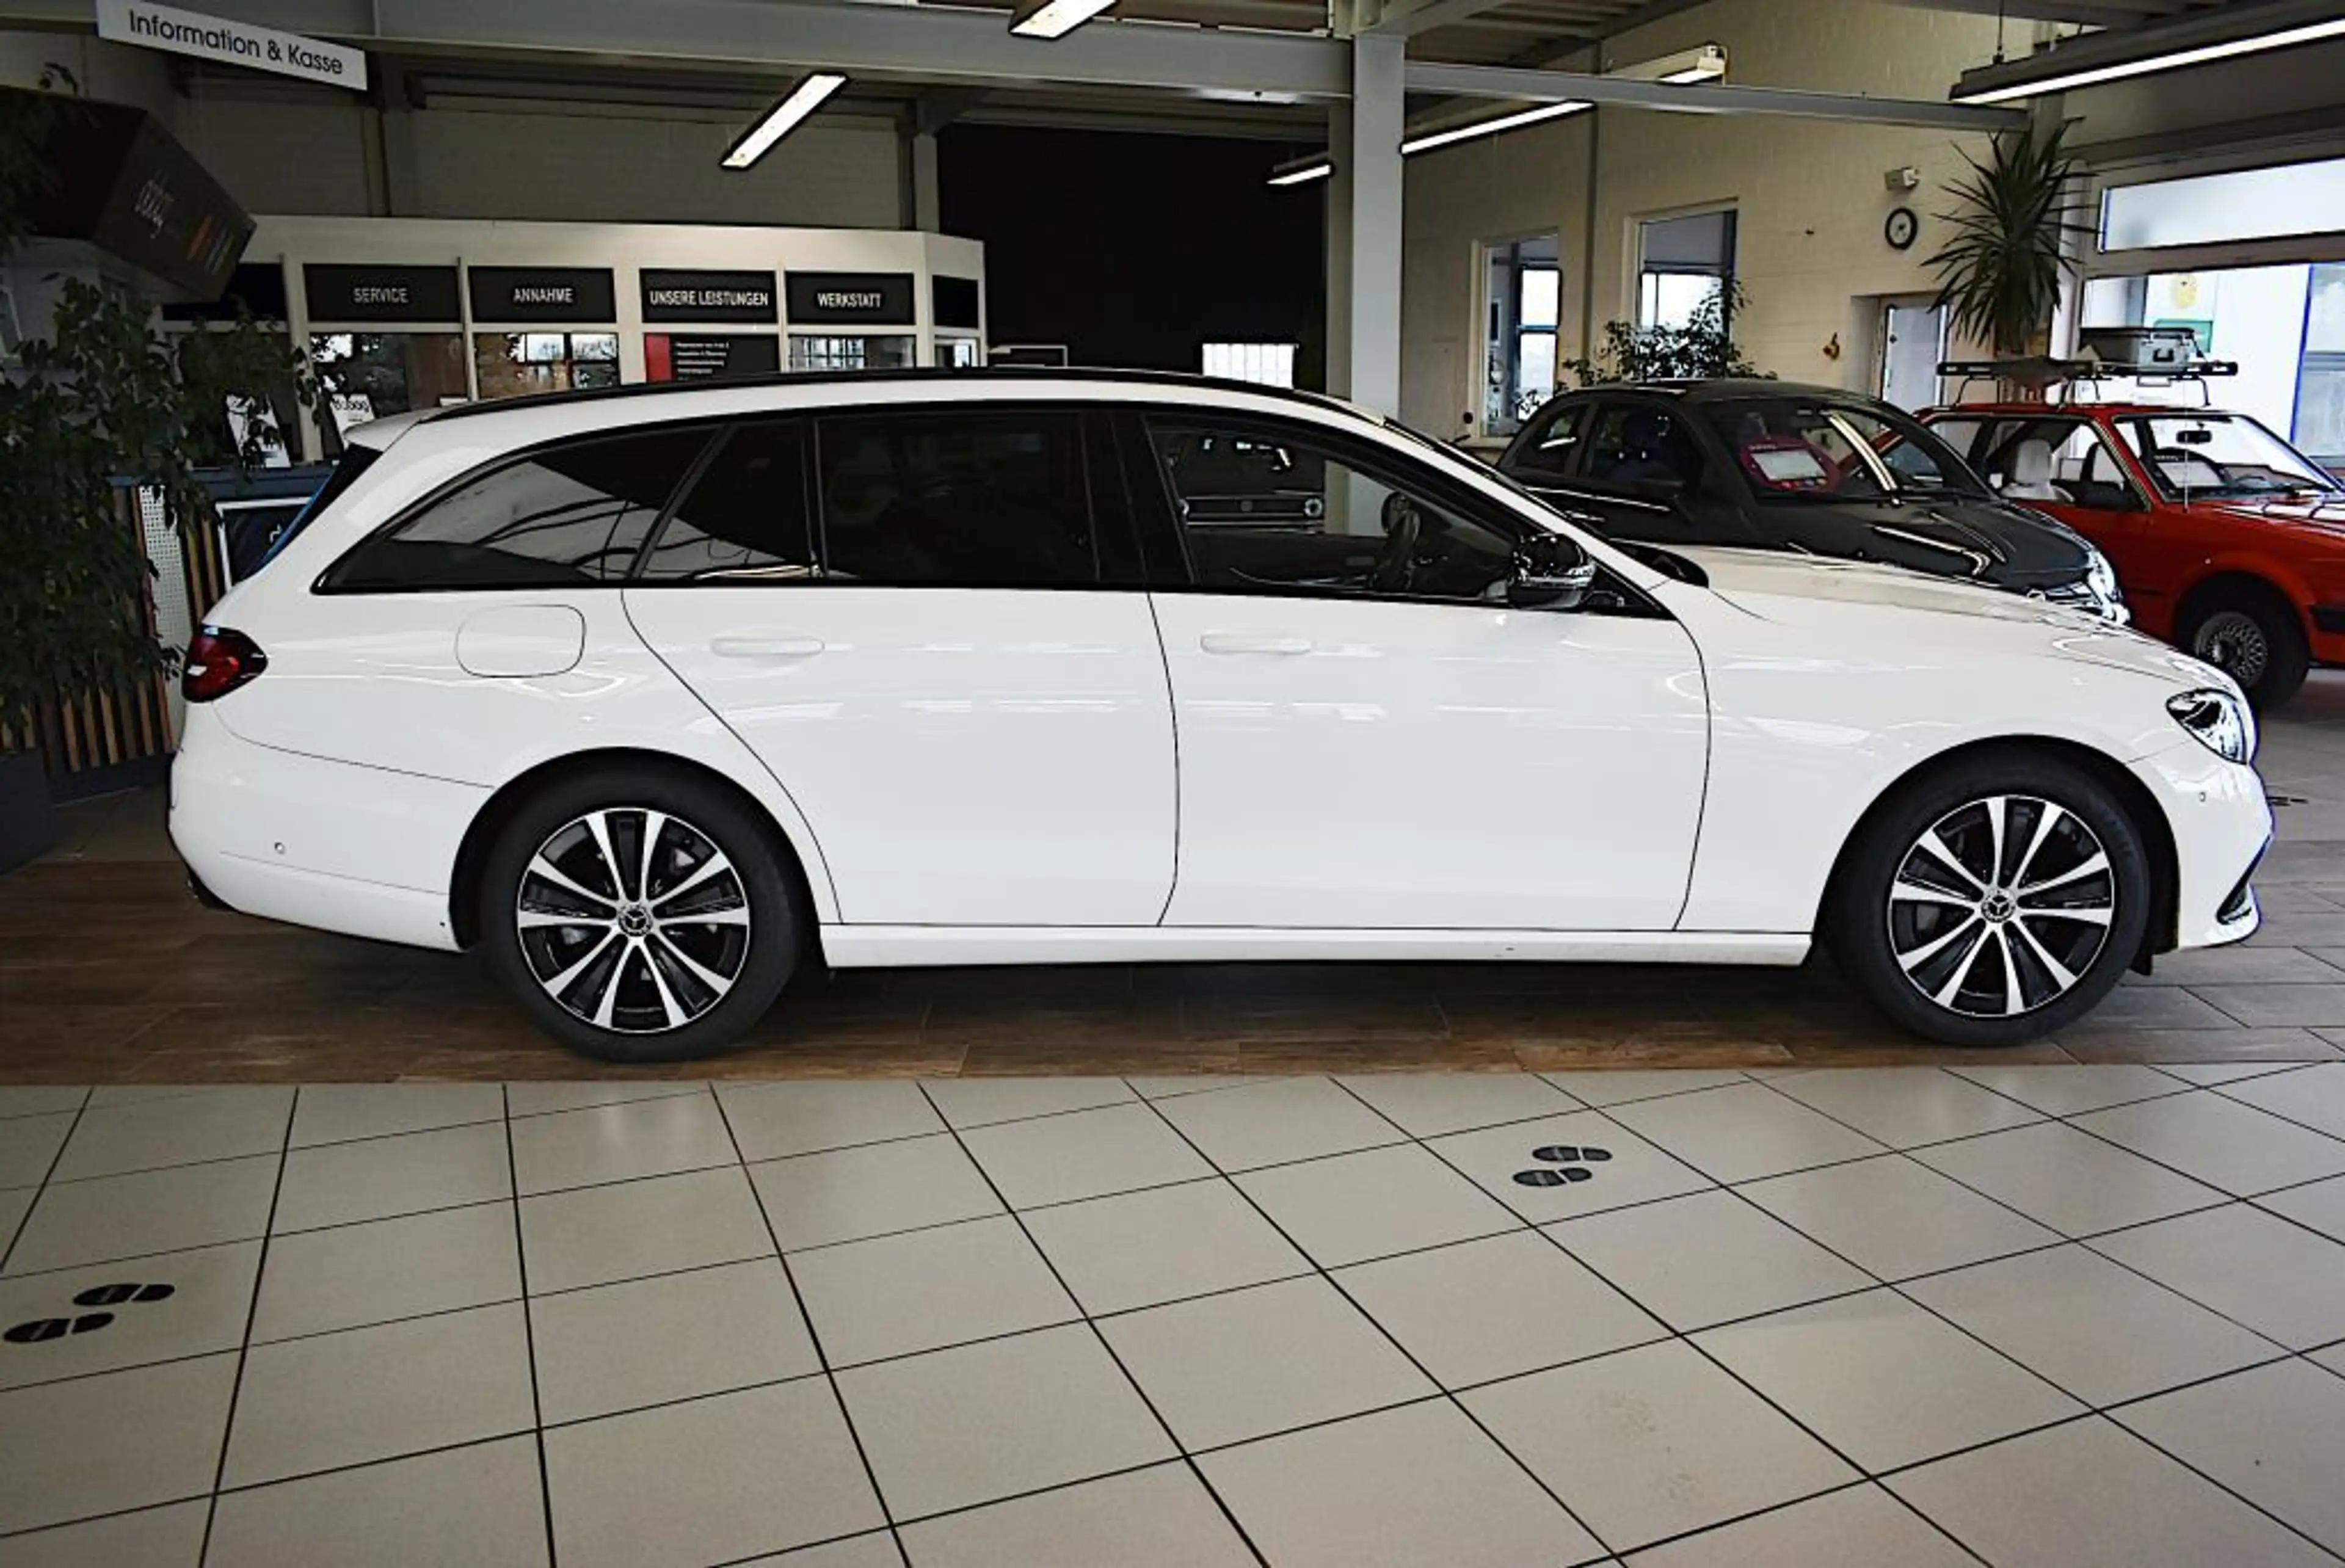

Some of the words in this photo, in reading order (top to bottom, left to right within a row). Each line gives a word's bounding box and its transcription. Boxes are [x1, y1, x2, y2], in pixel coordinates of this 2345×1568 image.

[129, 9, 260, 58] Information
[267, 39, 282, 62] &
[289, 44, 343, 74] Kasse
[354, 288, 409, 303] SERVICE
[513, 288, 573, 303] ANNAHME
[649, 290, 696, 305] UNSERE
[699, 291, 768, 306] LEISTUNGEN
[817, 292, 881, 308] WERKSTATT
